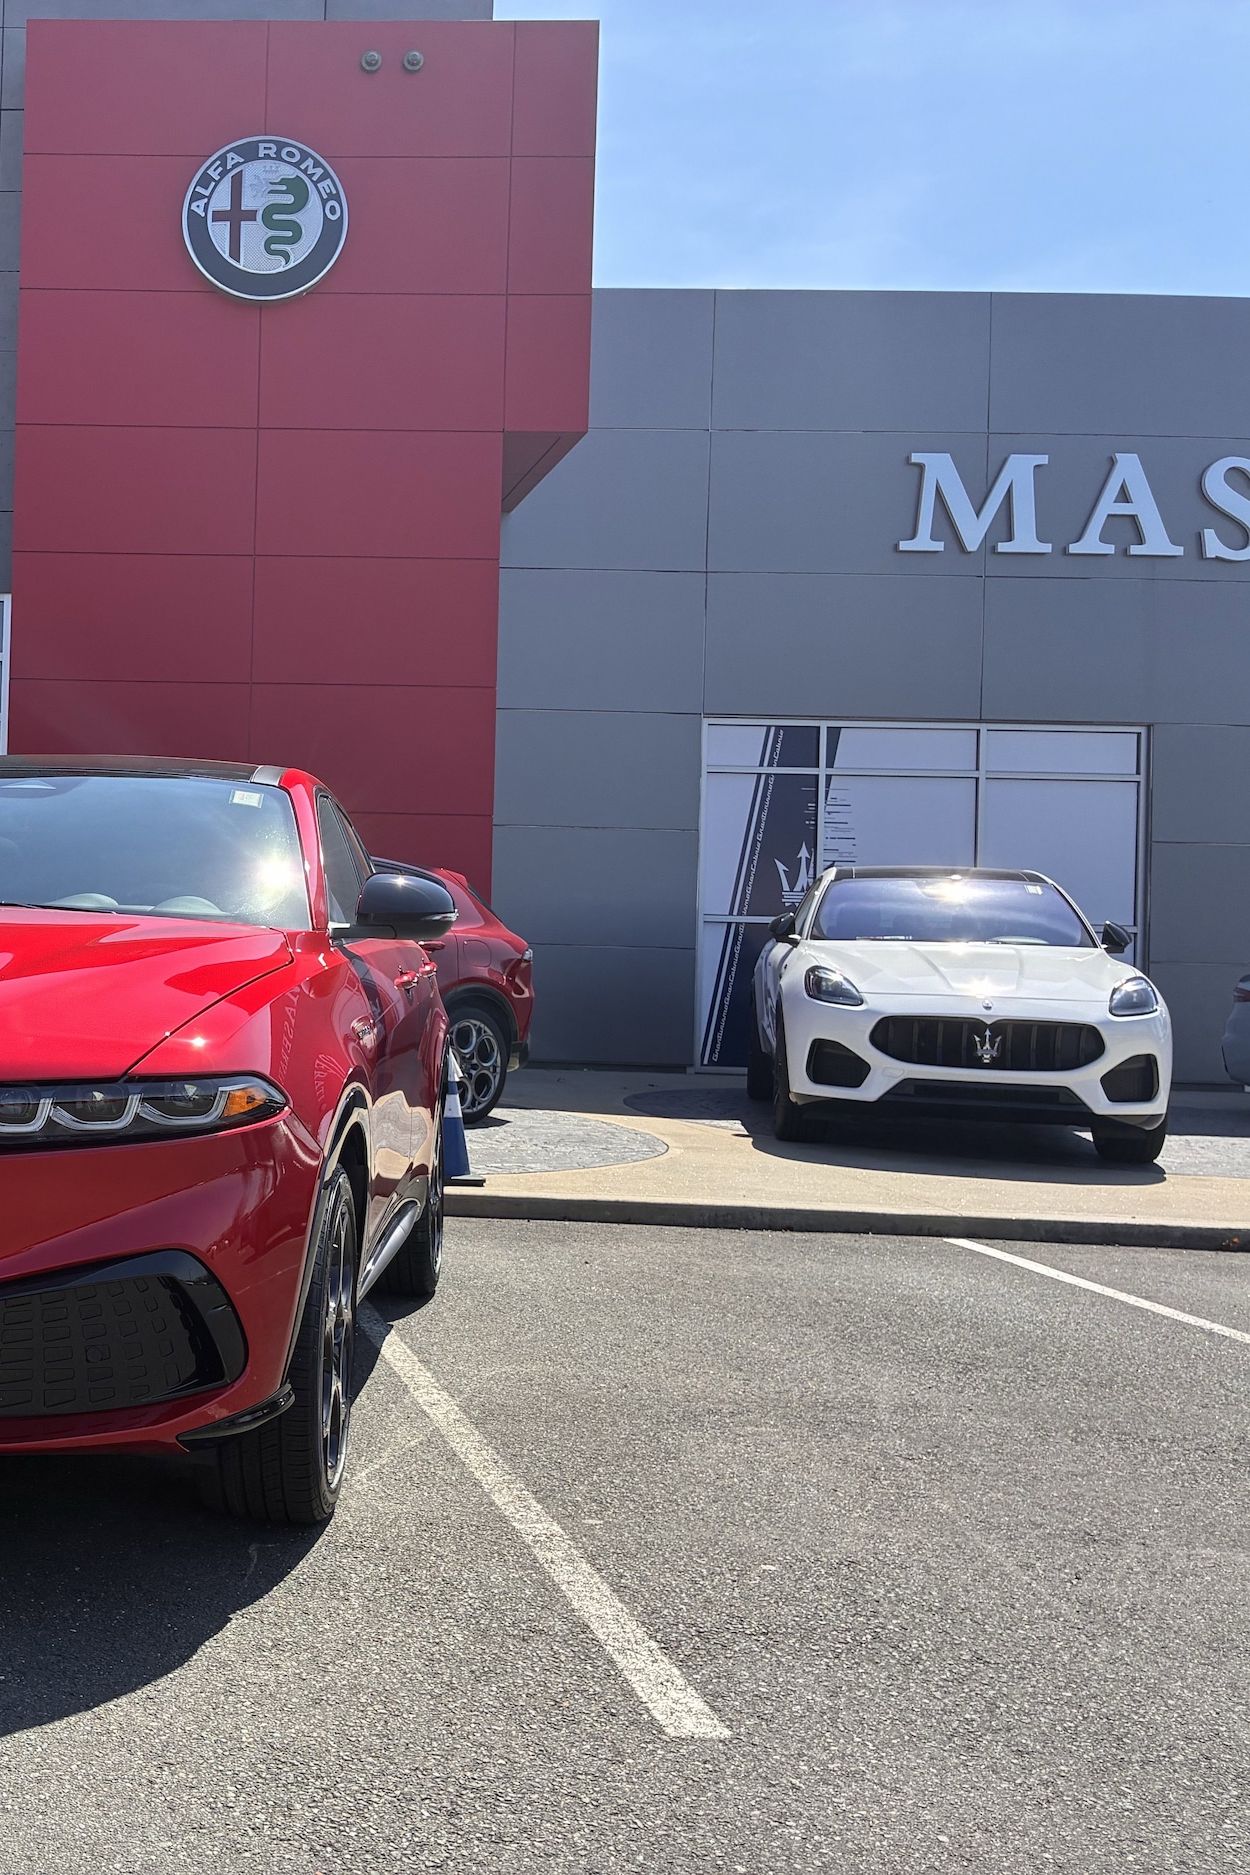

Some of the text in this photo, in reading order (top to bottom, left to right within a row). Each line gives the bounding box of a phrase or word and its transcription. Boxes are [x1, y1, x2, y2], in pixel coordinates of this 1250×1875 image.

[190, 142, 342, 221] ALFA ROMEO
[897, 452, 1250, 562] MAS
